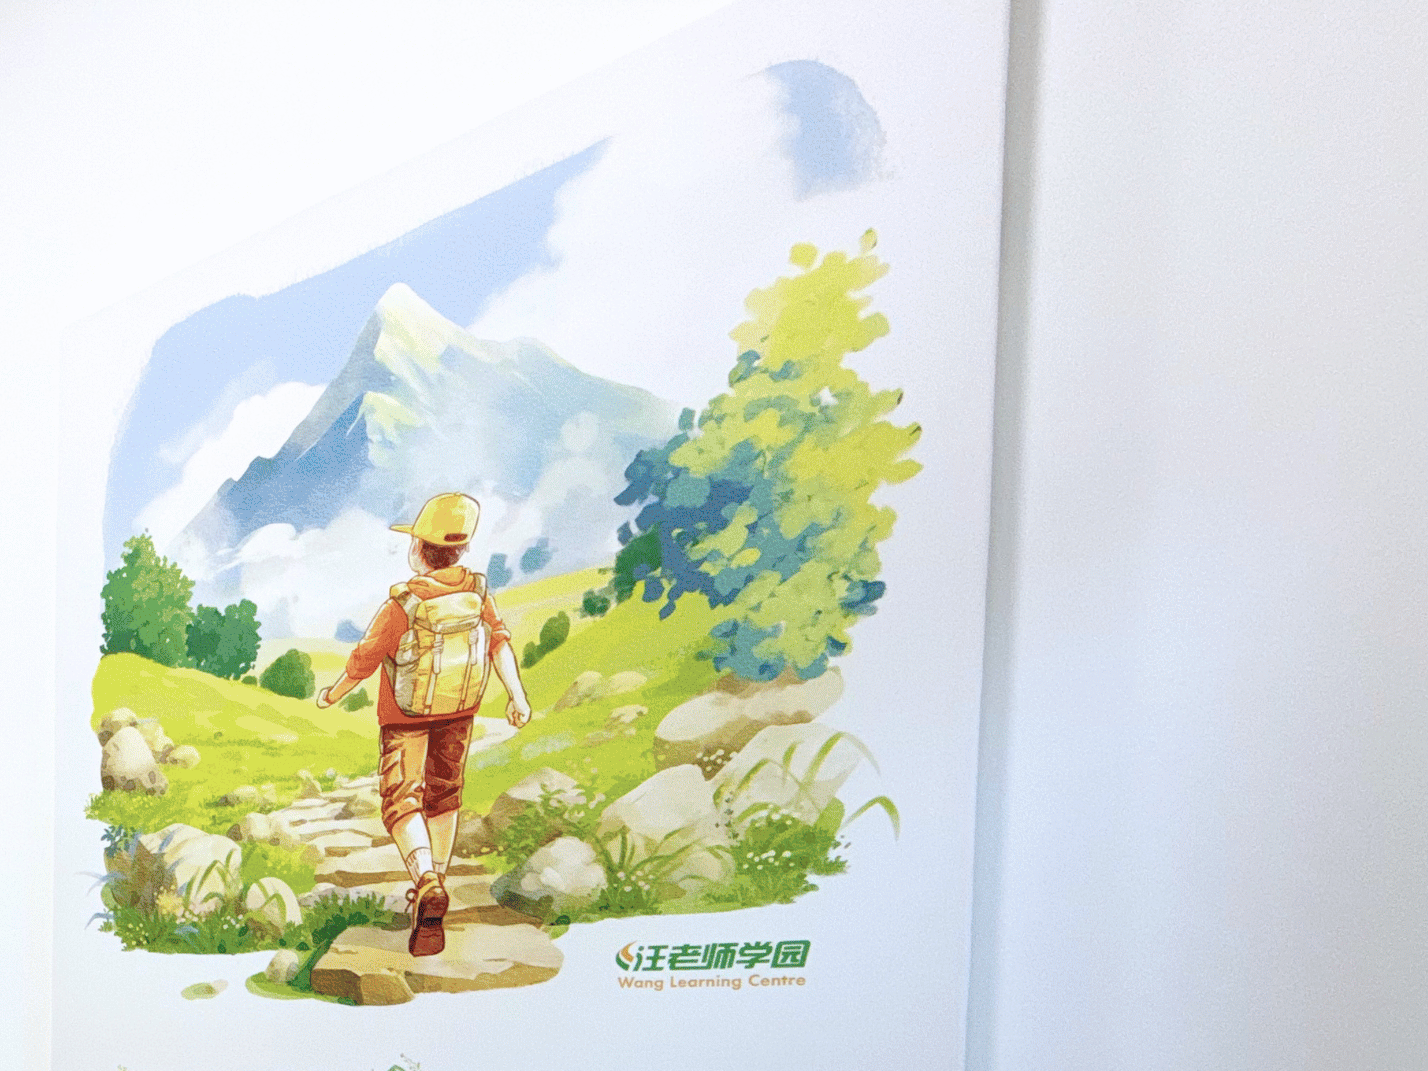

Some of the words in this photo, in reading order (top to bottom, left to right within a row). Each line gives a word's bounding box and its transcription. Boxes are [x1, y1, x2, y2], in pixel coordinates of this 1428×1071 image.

[633, 940, 811, 972] 汪老师学园
[618, 976, 664, 991] Wang
[670, 975, 742, 990] Learning
[748, 974, 806, 987] Centre
